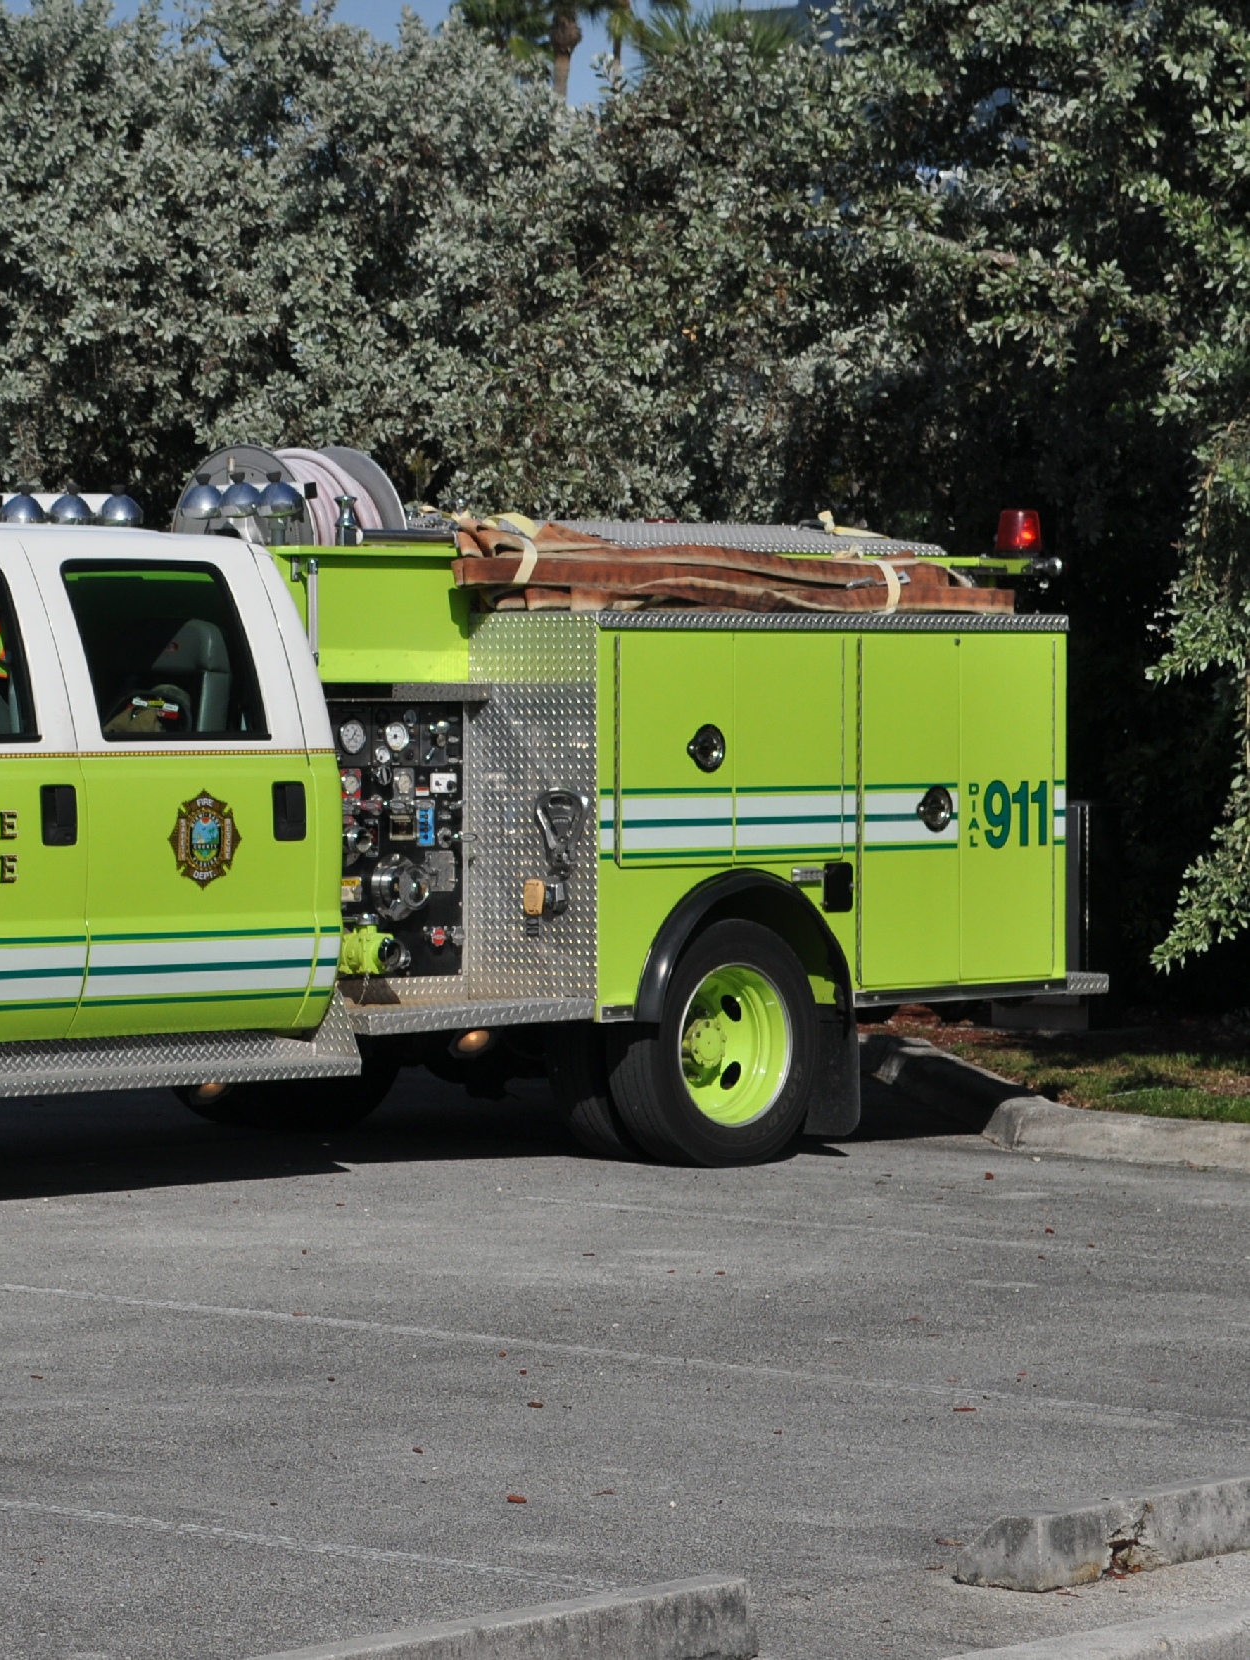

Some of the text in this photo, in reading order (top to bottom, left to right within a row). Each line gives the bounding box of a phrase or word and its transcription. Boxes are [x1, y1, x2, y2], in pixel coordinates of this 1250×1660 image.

[196, 798, 215, 807] FIRE
[968, 779, 1048, 849] DIAL 911
